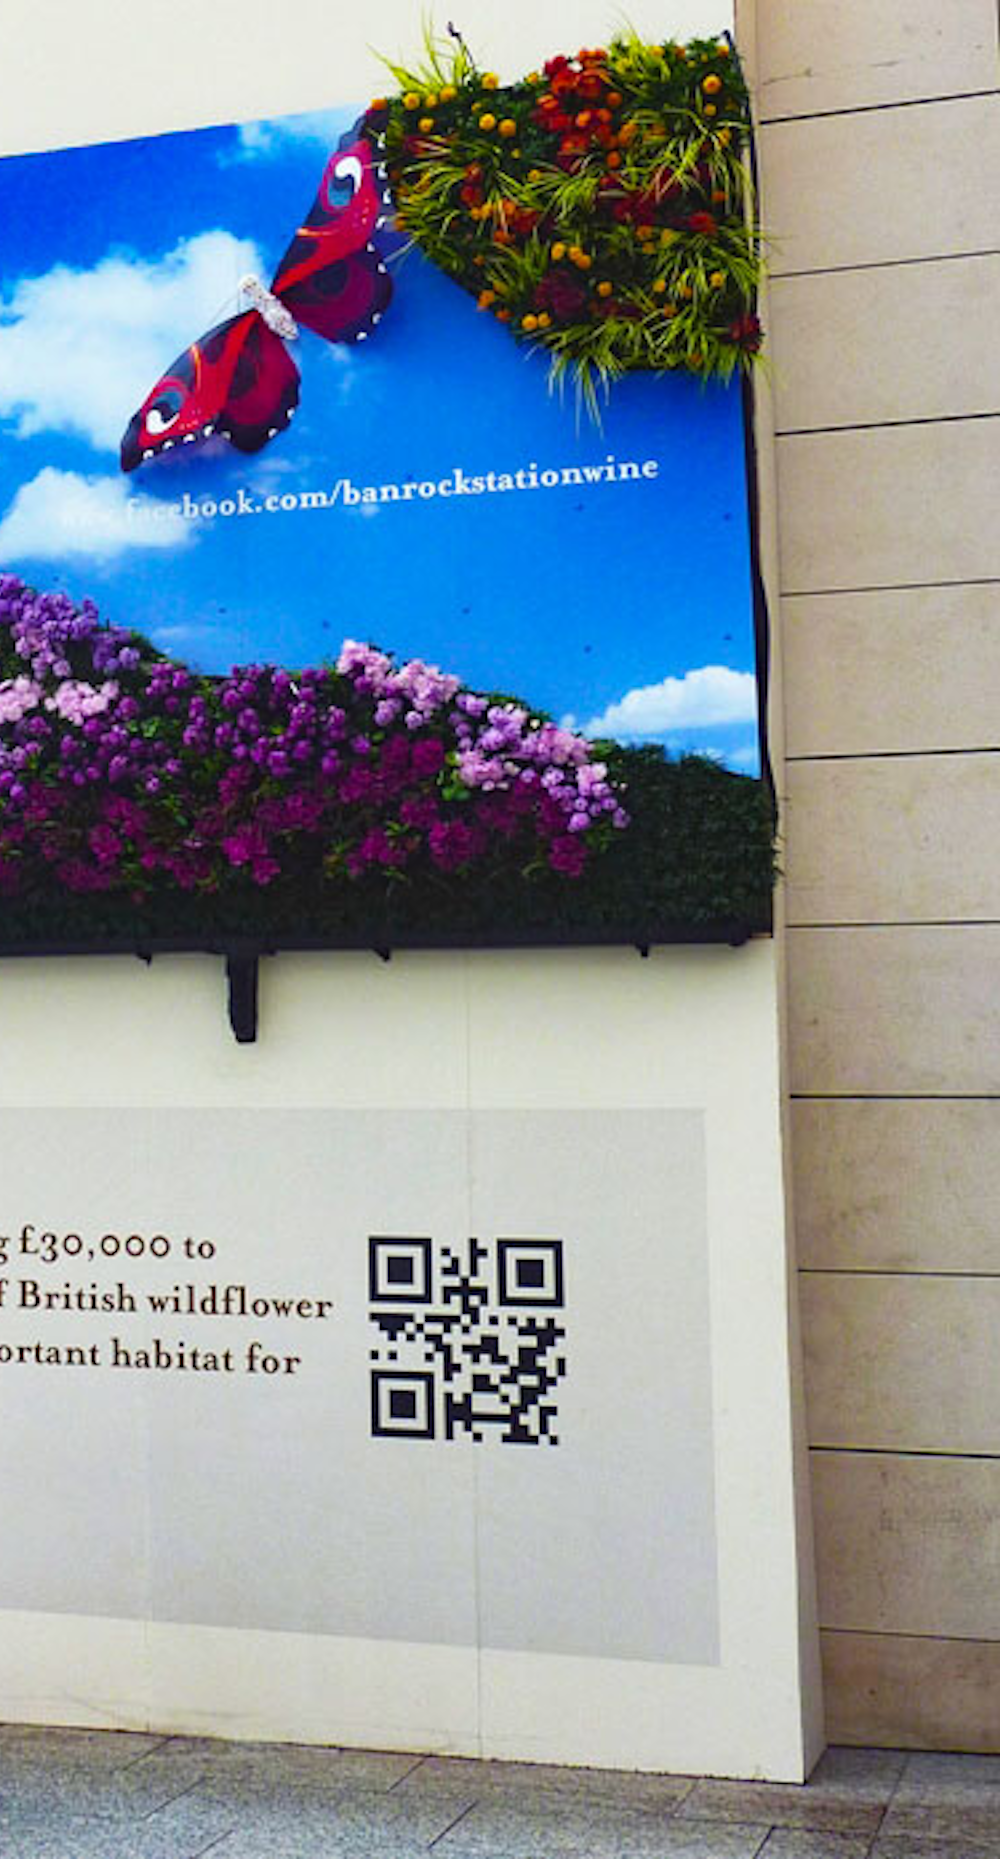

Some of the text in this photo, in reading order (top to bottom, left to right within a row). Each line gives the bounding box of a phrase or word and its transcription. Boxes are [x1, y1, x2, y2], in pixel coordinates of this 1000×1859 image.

[18, 1224, 172, 1263] £30,000
[184, 1236, 217, 1260] to
[17, 1279, 138, 1313] British
[146, 1284, 334, 1320] wildflower
[111, 1335, 236, 1374] habitat
[245, 1341, 302, 1375] for
